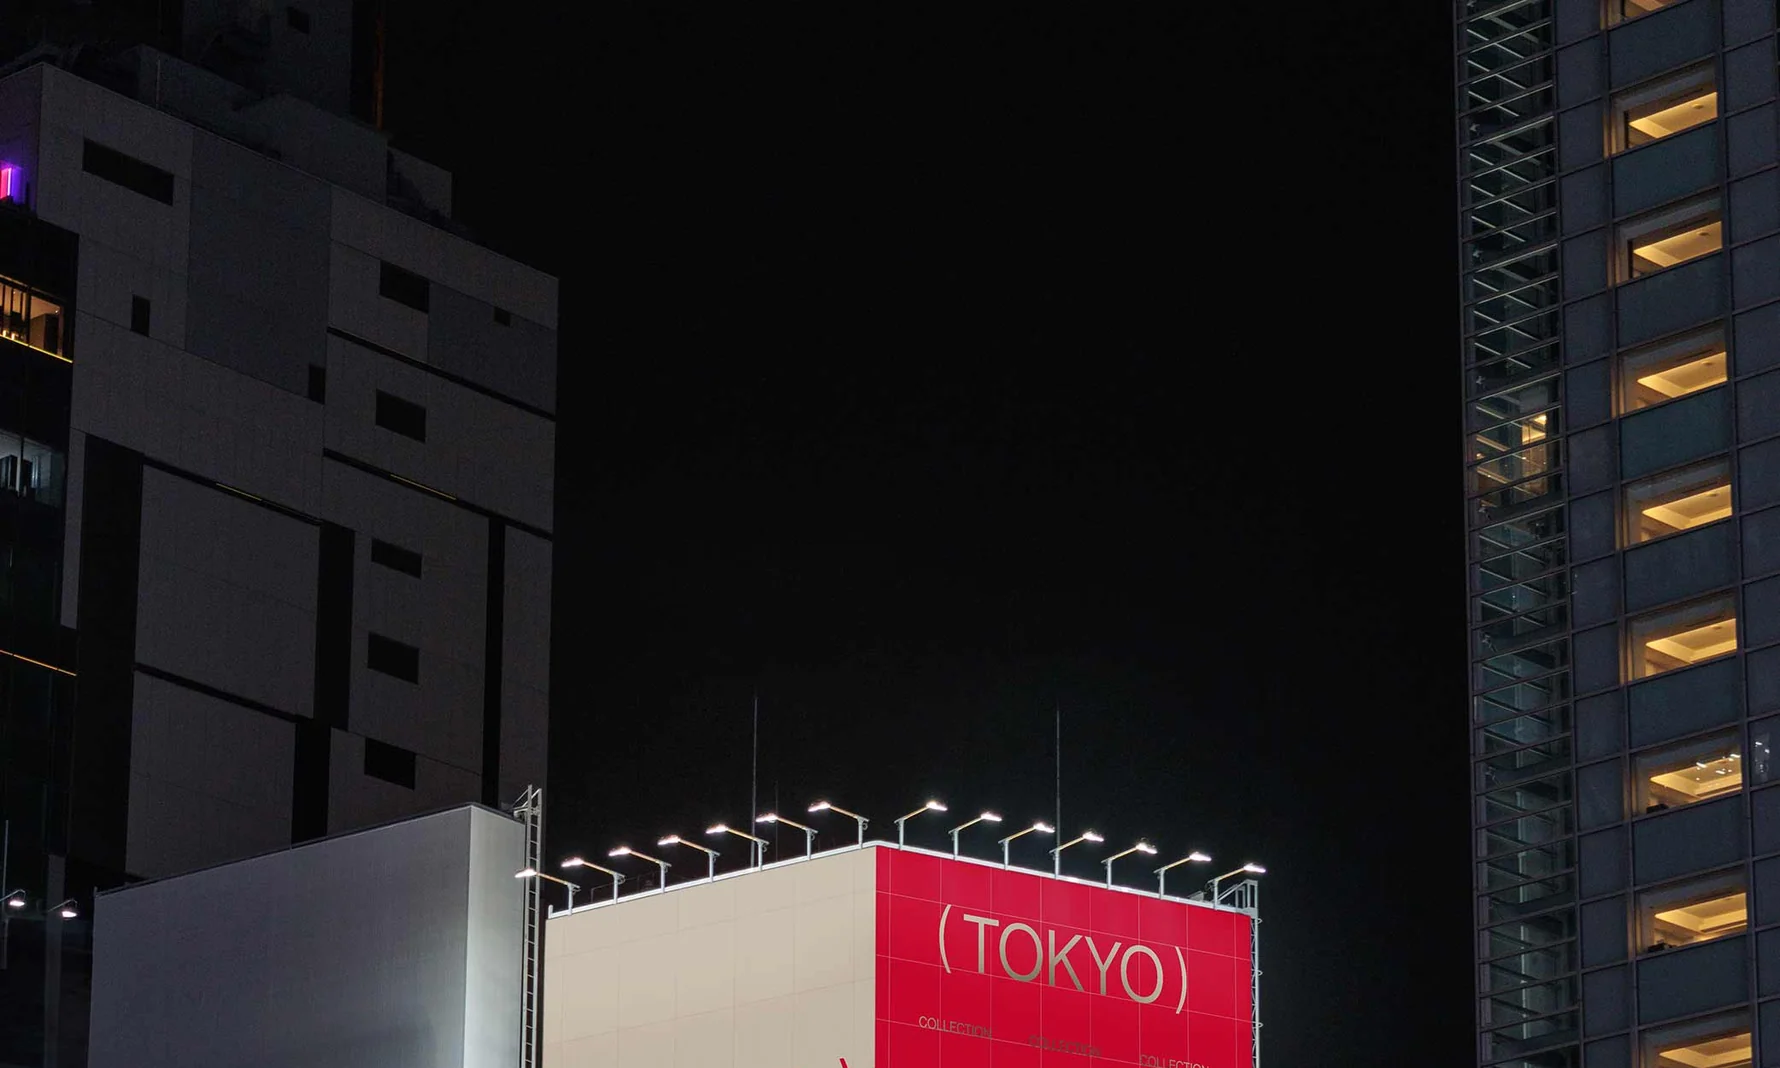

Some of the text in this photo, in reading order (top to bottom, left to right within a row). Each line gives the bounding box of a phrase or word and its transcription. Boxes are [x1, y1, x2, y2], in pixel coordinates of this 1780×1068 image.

[939, 904, 1188, 1014] (TOKYO)
[919, 1016, 992, 1038] COLLECTION
[1029, 1035, 1101, 1056] COLLECTION
